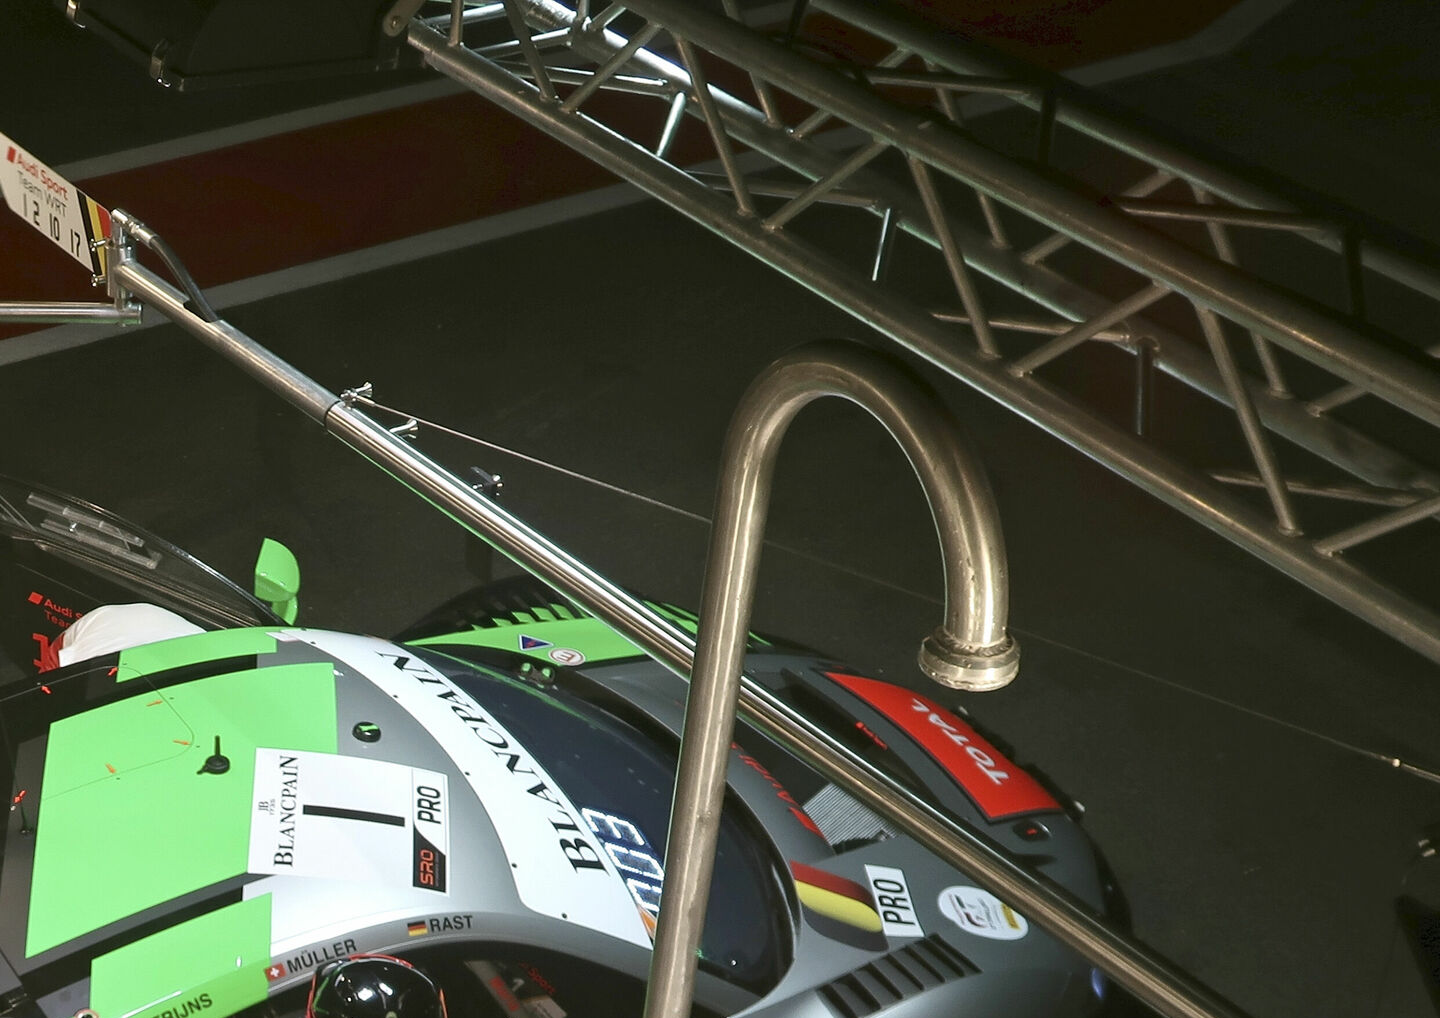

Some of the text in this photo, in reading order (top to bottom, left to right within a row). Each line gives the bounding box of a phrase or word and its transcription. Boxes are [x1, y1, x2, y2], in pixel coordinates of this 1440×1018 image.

[16, 153, 68, 201] Audi Sport
[17, 170, 67, 218] Team WRT
[32, 201, 41, 226] 2
[49, 213, 60, 242] 10
[70, 228, 81, 258] 17
[44, 598, 72, 618] Audi
[377, 650, 610, 876] BLANCPAIN
[912, 698, 1010, 785] TOTAL
[273, 755, 298, 868] BLANCPAIN
[417, 785, 442, 825] PRO
[419, 849, 434, 886] SRO
[430, 914, 474, 933] RAST
[873, 877, 916, 927] PRO
[286, 938, 359, 975] MÜLLER
